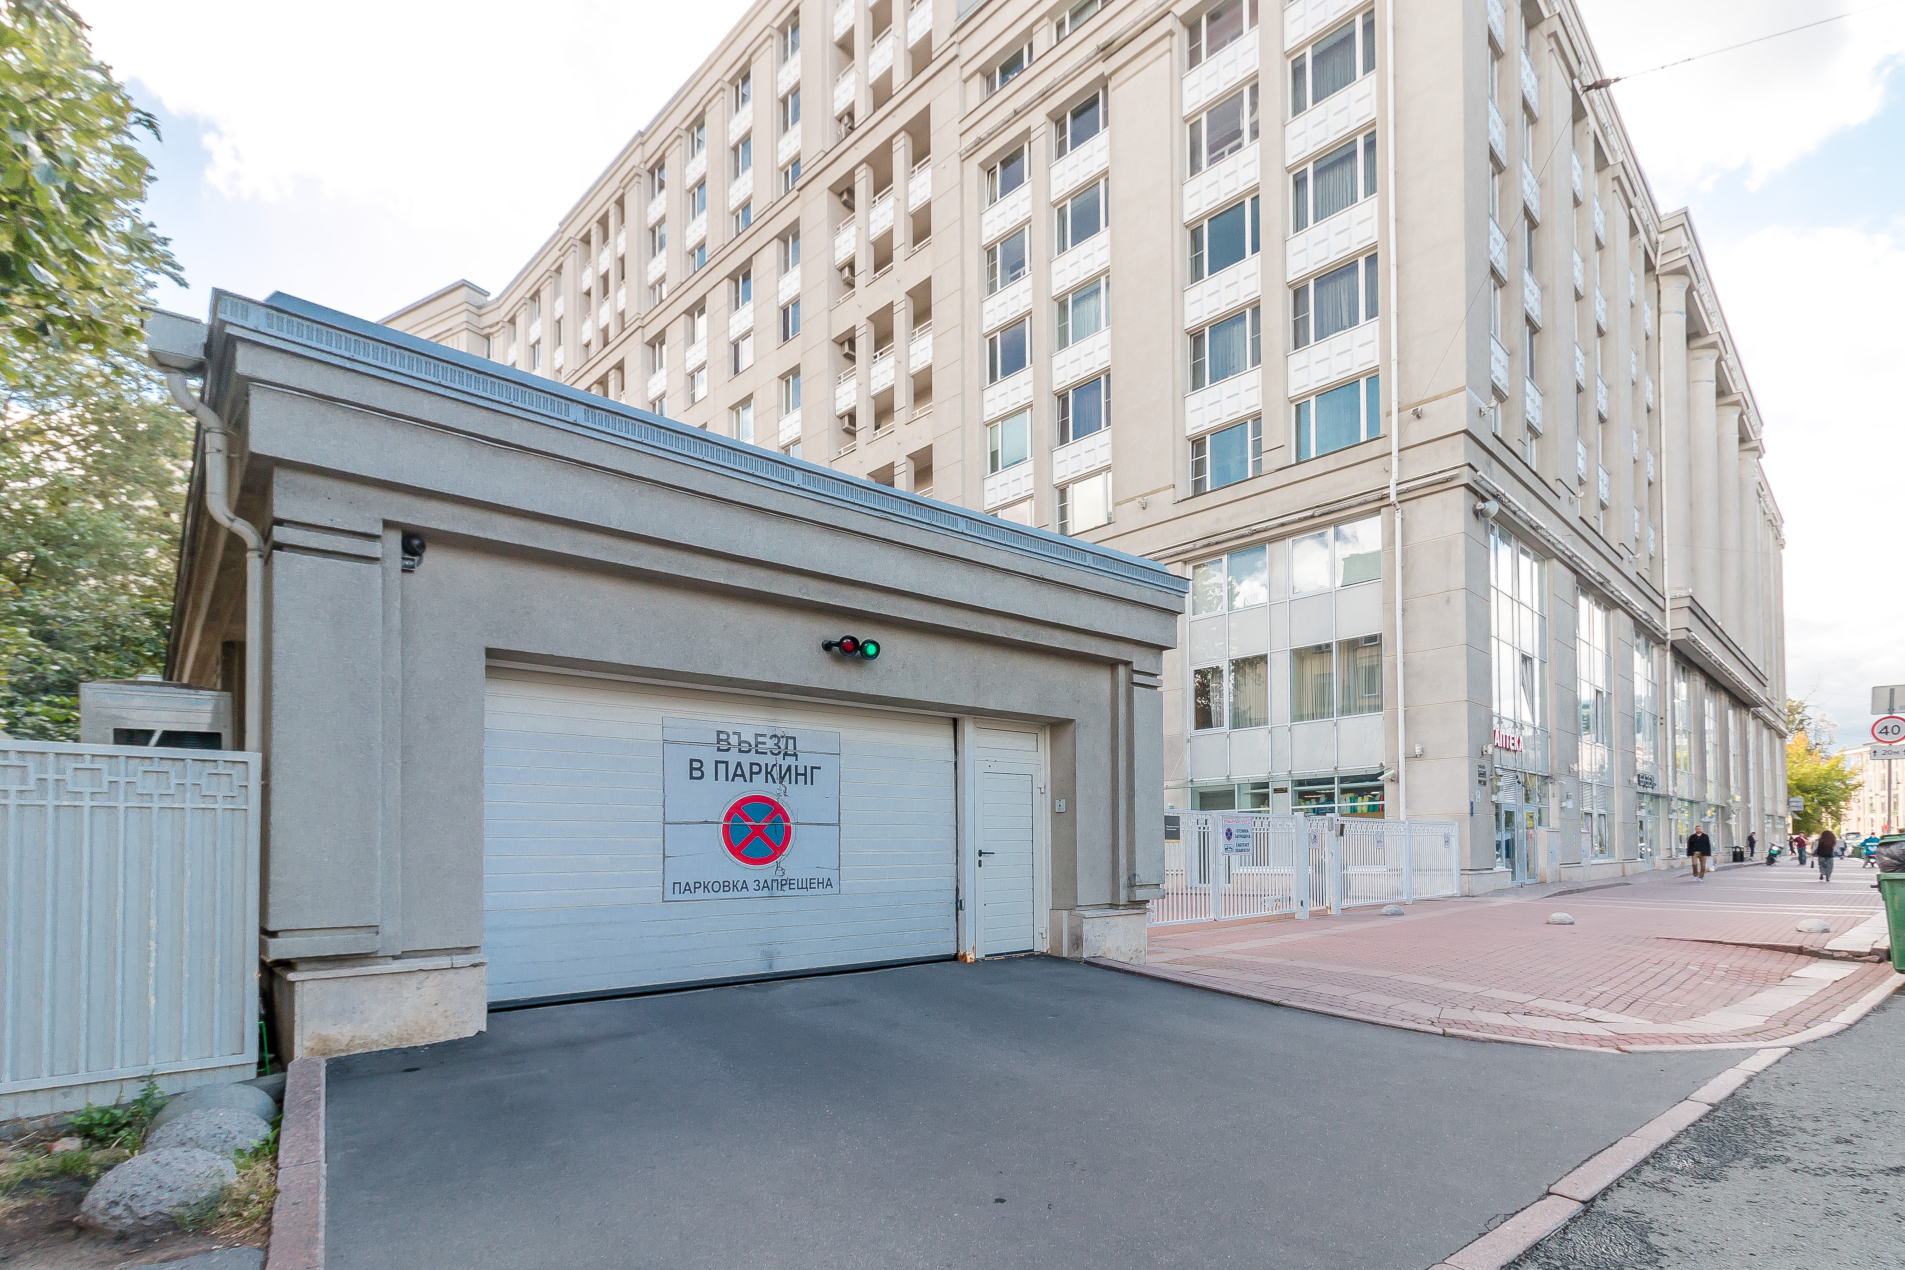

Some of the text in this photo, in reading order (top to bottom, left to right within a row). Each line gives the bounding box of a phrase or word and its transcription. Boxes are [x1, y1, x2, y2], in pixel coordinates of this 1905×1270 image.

[1494, 729, 1524, 752] АПТЕКА
[1878, 724, 1901, 736] 40
[716, 730, 798, 761] ВЪЕЗД
[689, 758, 821, 786] В ПАРКИНГ
[672, 877, 833, 895] ПАРКОВКА ЗАПРЕЩЕНА
